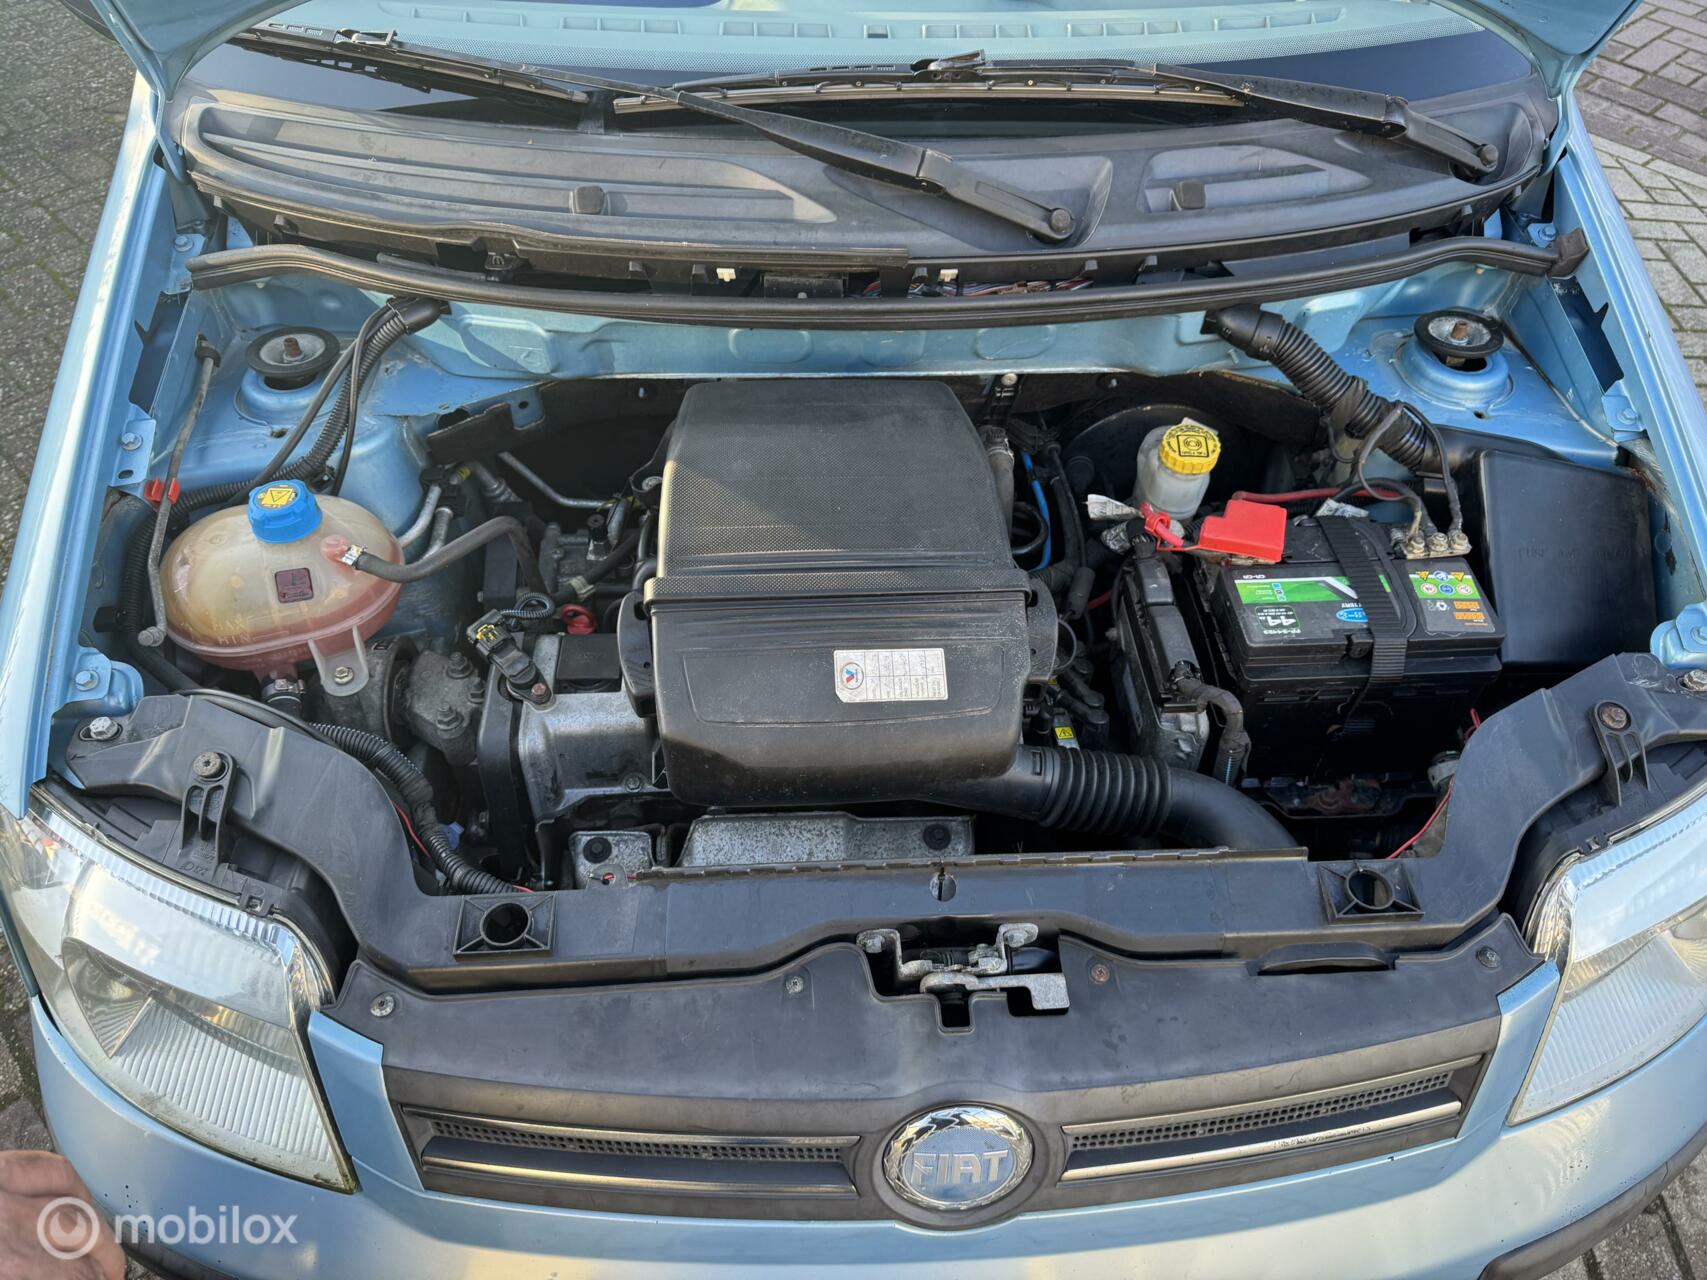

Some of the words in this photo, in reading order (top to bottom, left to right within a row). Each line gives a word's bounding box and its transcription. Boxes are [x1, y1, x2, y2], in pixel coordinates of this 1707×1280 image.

[1266, 615, 1297, 627] 44
[218, 630, 250, 646] MIN
[910, 1149, 1009, 1185] FIAT
